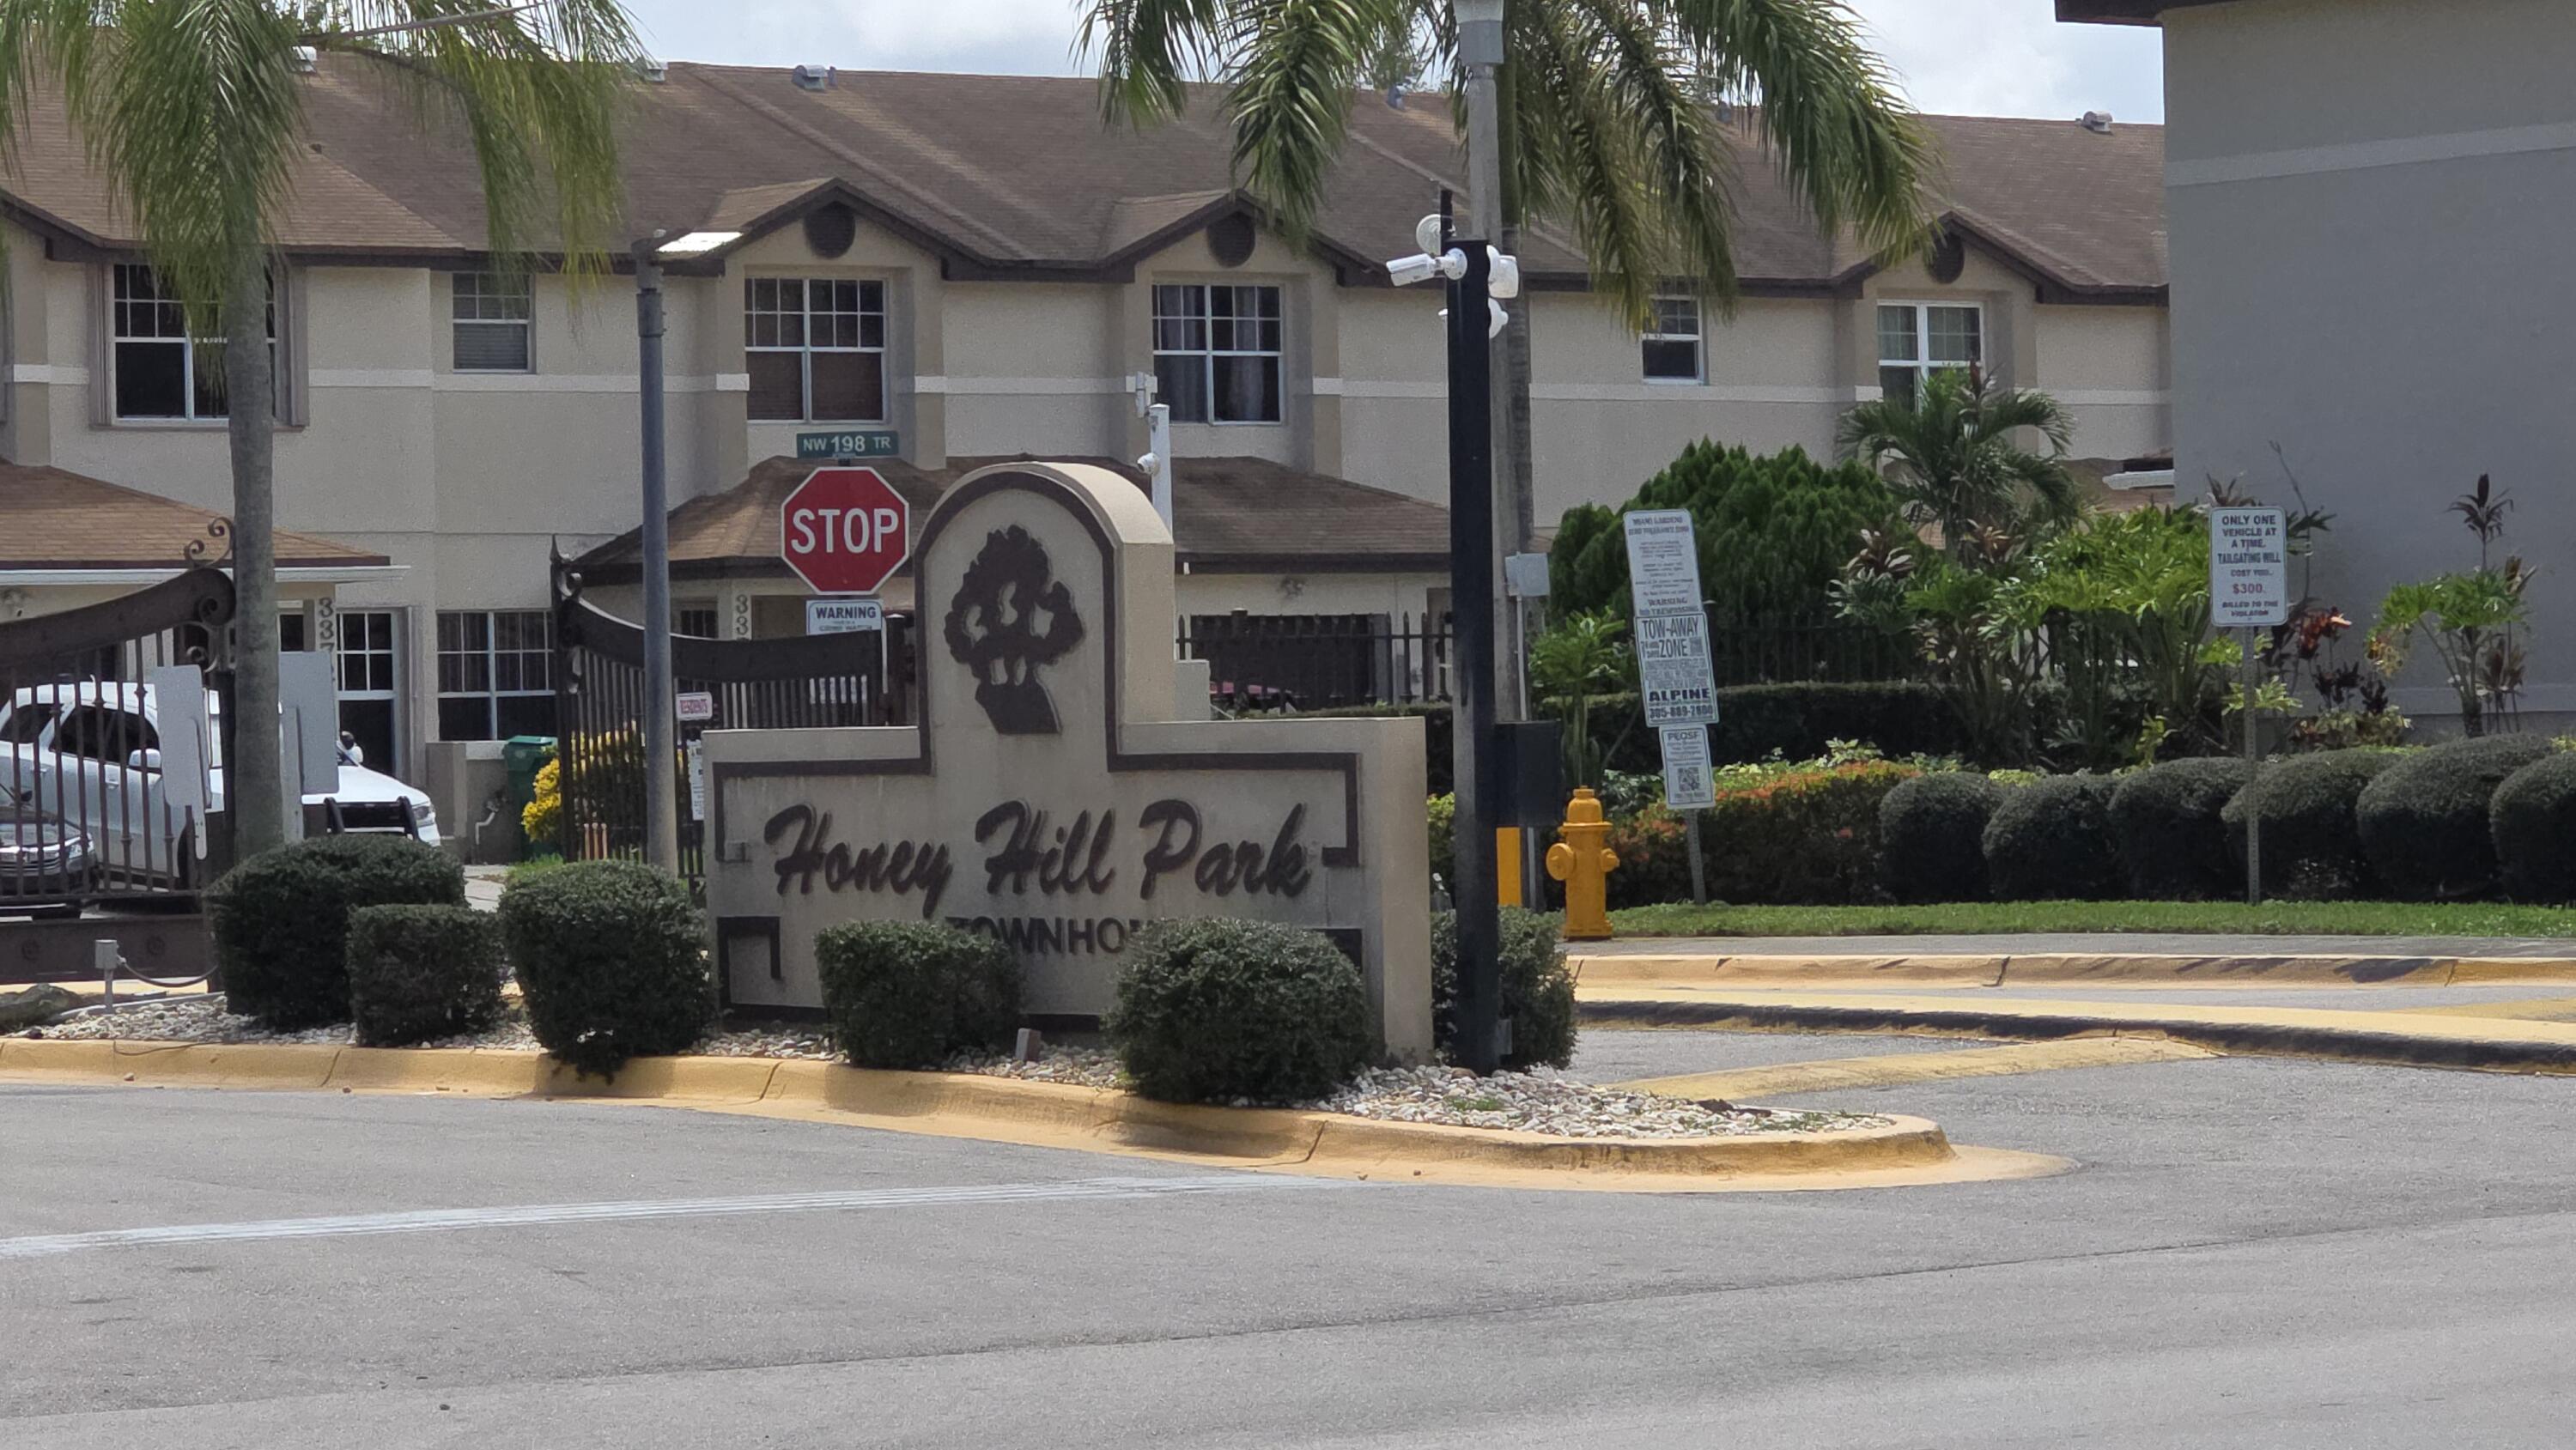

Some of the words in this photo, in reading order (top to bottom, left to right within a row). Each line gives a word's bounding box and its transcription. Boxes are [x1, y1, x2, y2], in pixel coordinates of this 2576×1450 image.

[803, 438, 826, 452] NW
[831, 435, 866, 453] 198
[873, 436, 890, 449] TR
[2221, 515, 2250, 525] ONLY
[2253, 515, 2276, 525] ONE
[791, 508, 899, 554] STOP
[2222, 527, 2263, 537] VEHICLE
[2265, 527, 2277, 536] AT
[2231, 539, 2239, 548] A
[2218, 553, 2261, 564] TAILGATING
[2263, 552, 2281, 563] WILL
[816, 606, 877, 619] WARNING
[1641, 616, 1699, 640] TOW-AWAY
[1658, 638, 1688, 658] ZONE
[1649, 688, 1710, 702] ALPINE
[764, 804, 952, 919] Honey
[975, 800, 1115, 895] Hill
[1139, 799, 1312, 901] Park
